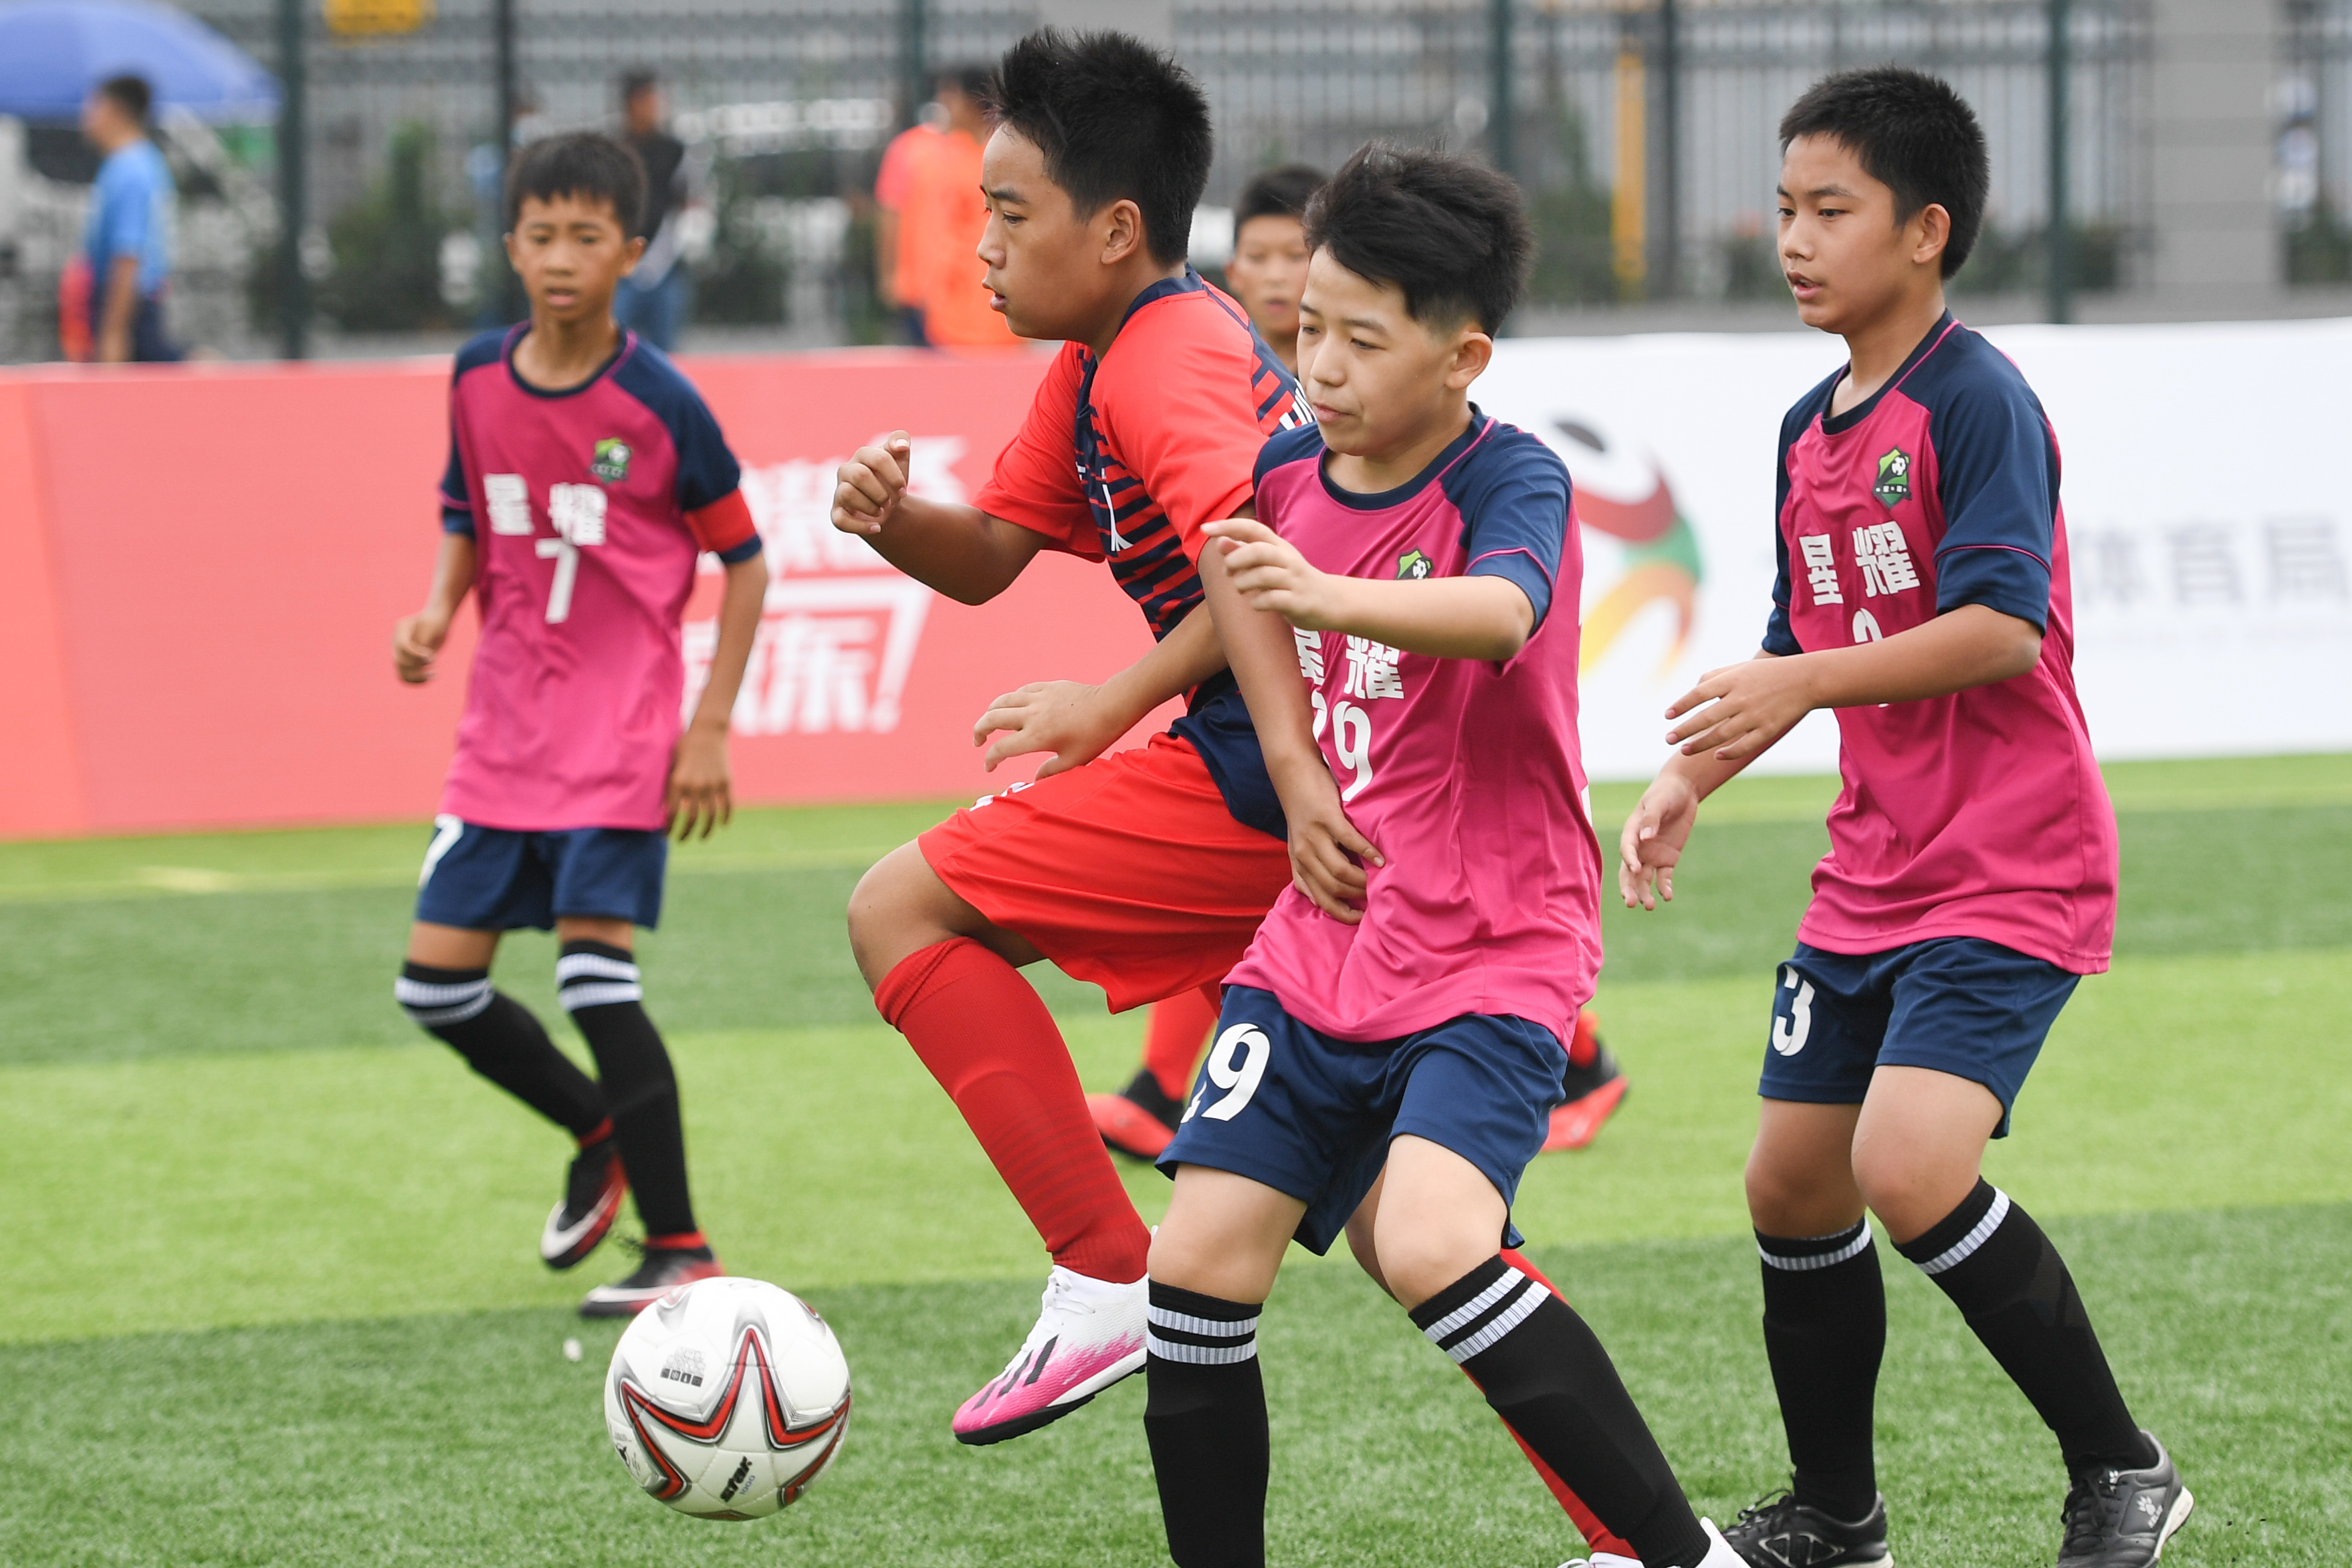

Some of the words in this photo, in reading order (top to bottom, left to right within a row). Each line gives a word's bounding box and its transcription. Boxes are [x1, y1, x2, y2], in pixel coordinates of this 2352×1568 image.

[535, 537, 580, 624] 7
[1799, 521, 1920, 605] 星耀
[1772, 964, 1816, 1056] 3
